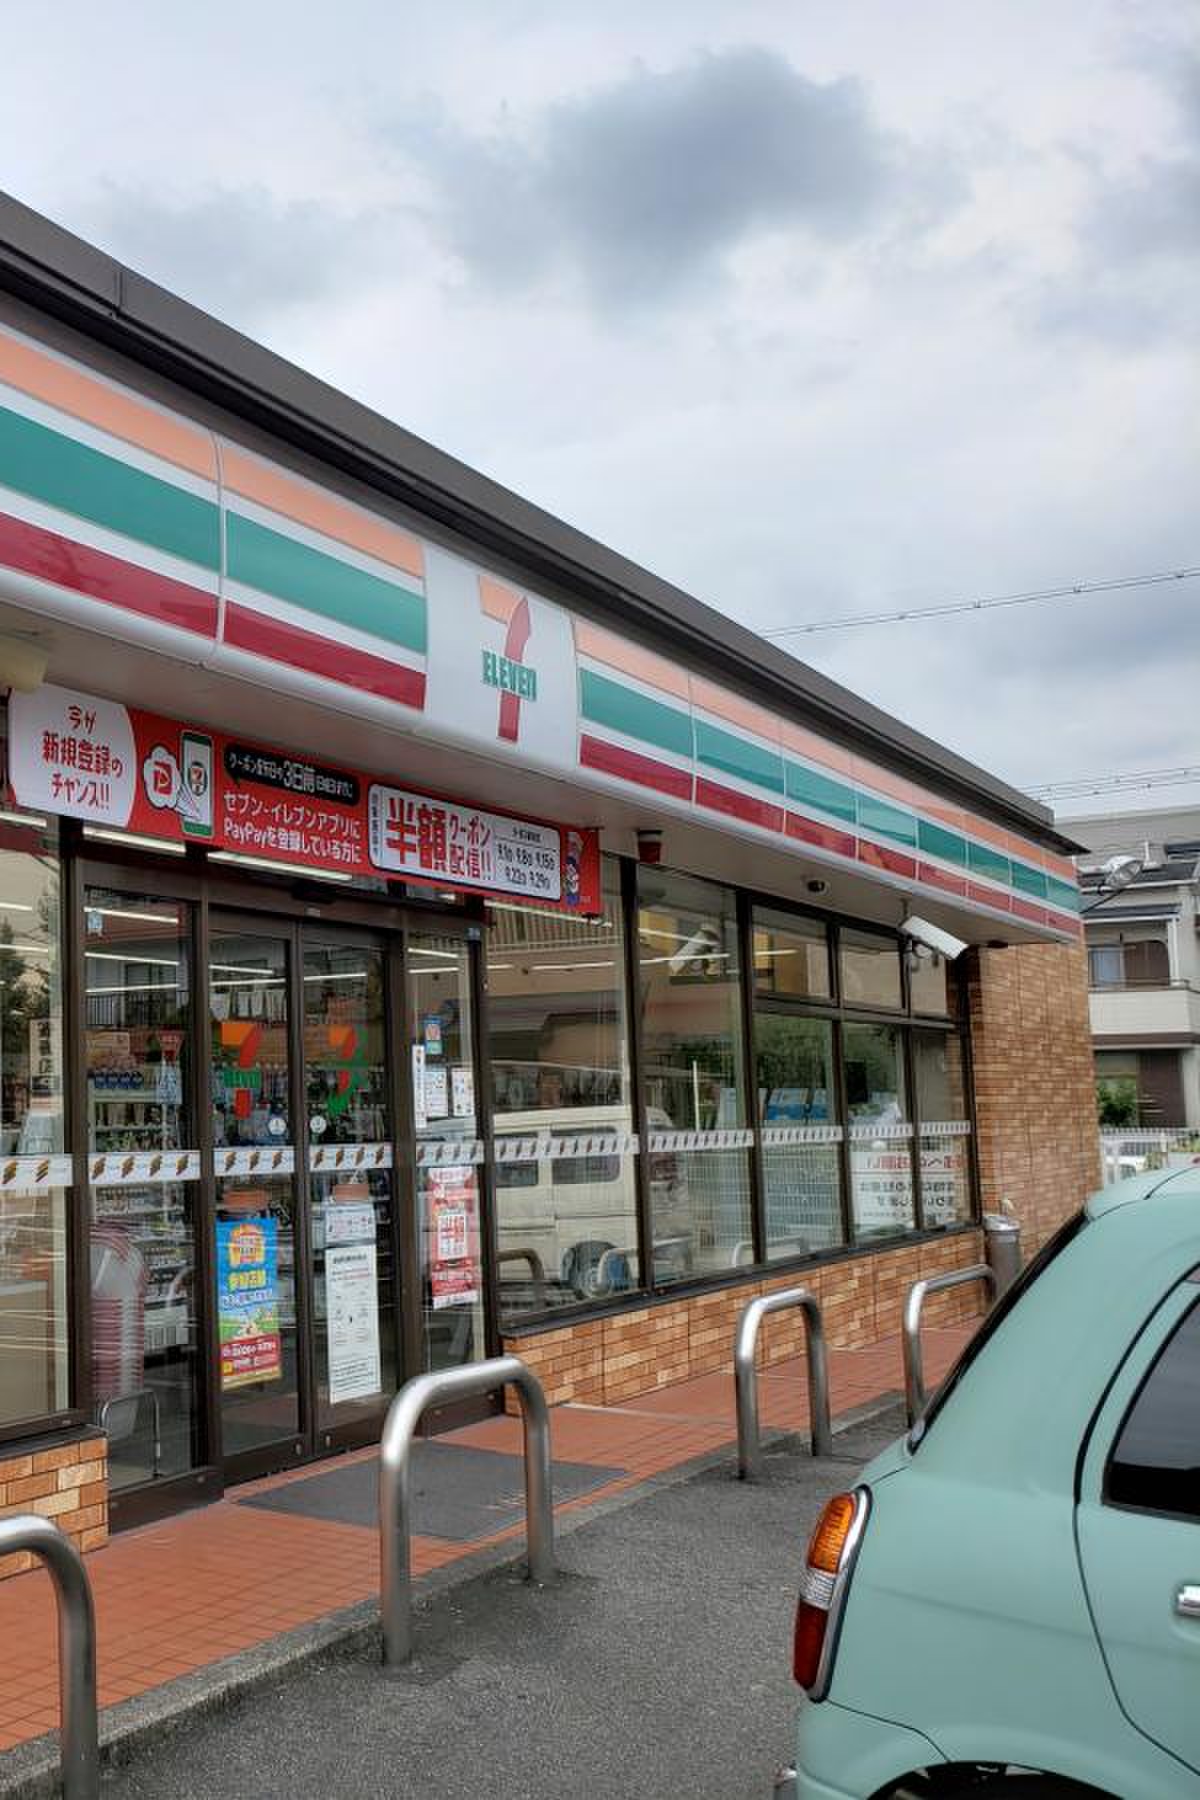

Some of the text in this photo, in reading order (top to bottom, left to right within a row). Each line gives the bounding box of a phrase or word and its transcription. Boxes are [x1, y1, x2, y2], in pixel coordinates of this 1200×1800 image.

[68, 704, 97, 731] 今が
[41, 730, 124, 779] 新規登録の
[51, 771, 111, 811] チャンス!!
[223, 816, 362, 865] PayPayを登録している方に
[386, 797, 447, 872] 半額
[449, 812, 491, 847] クーポン
